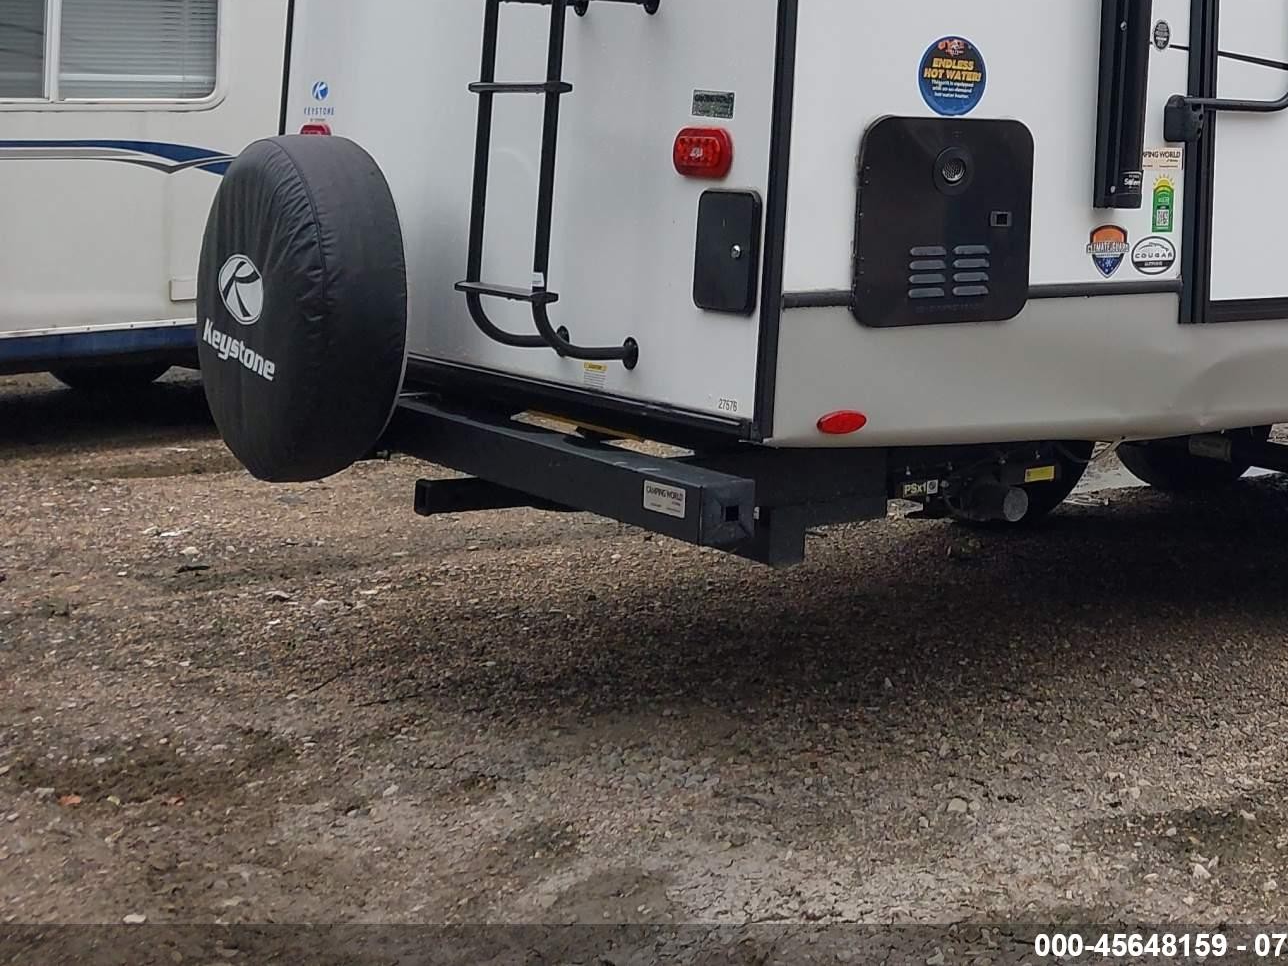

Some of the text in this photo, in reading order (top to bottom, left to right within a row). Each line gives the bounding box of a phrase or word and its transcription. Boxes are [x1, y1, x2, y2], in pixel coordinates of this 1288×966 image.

[932, 57, 975, 71] ENDLESS
[923, 67, 945, 79] HOT
[203, 317, 276, 381] Keystone
